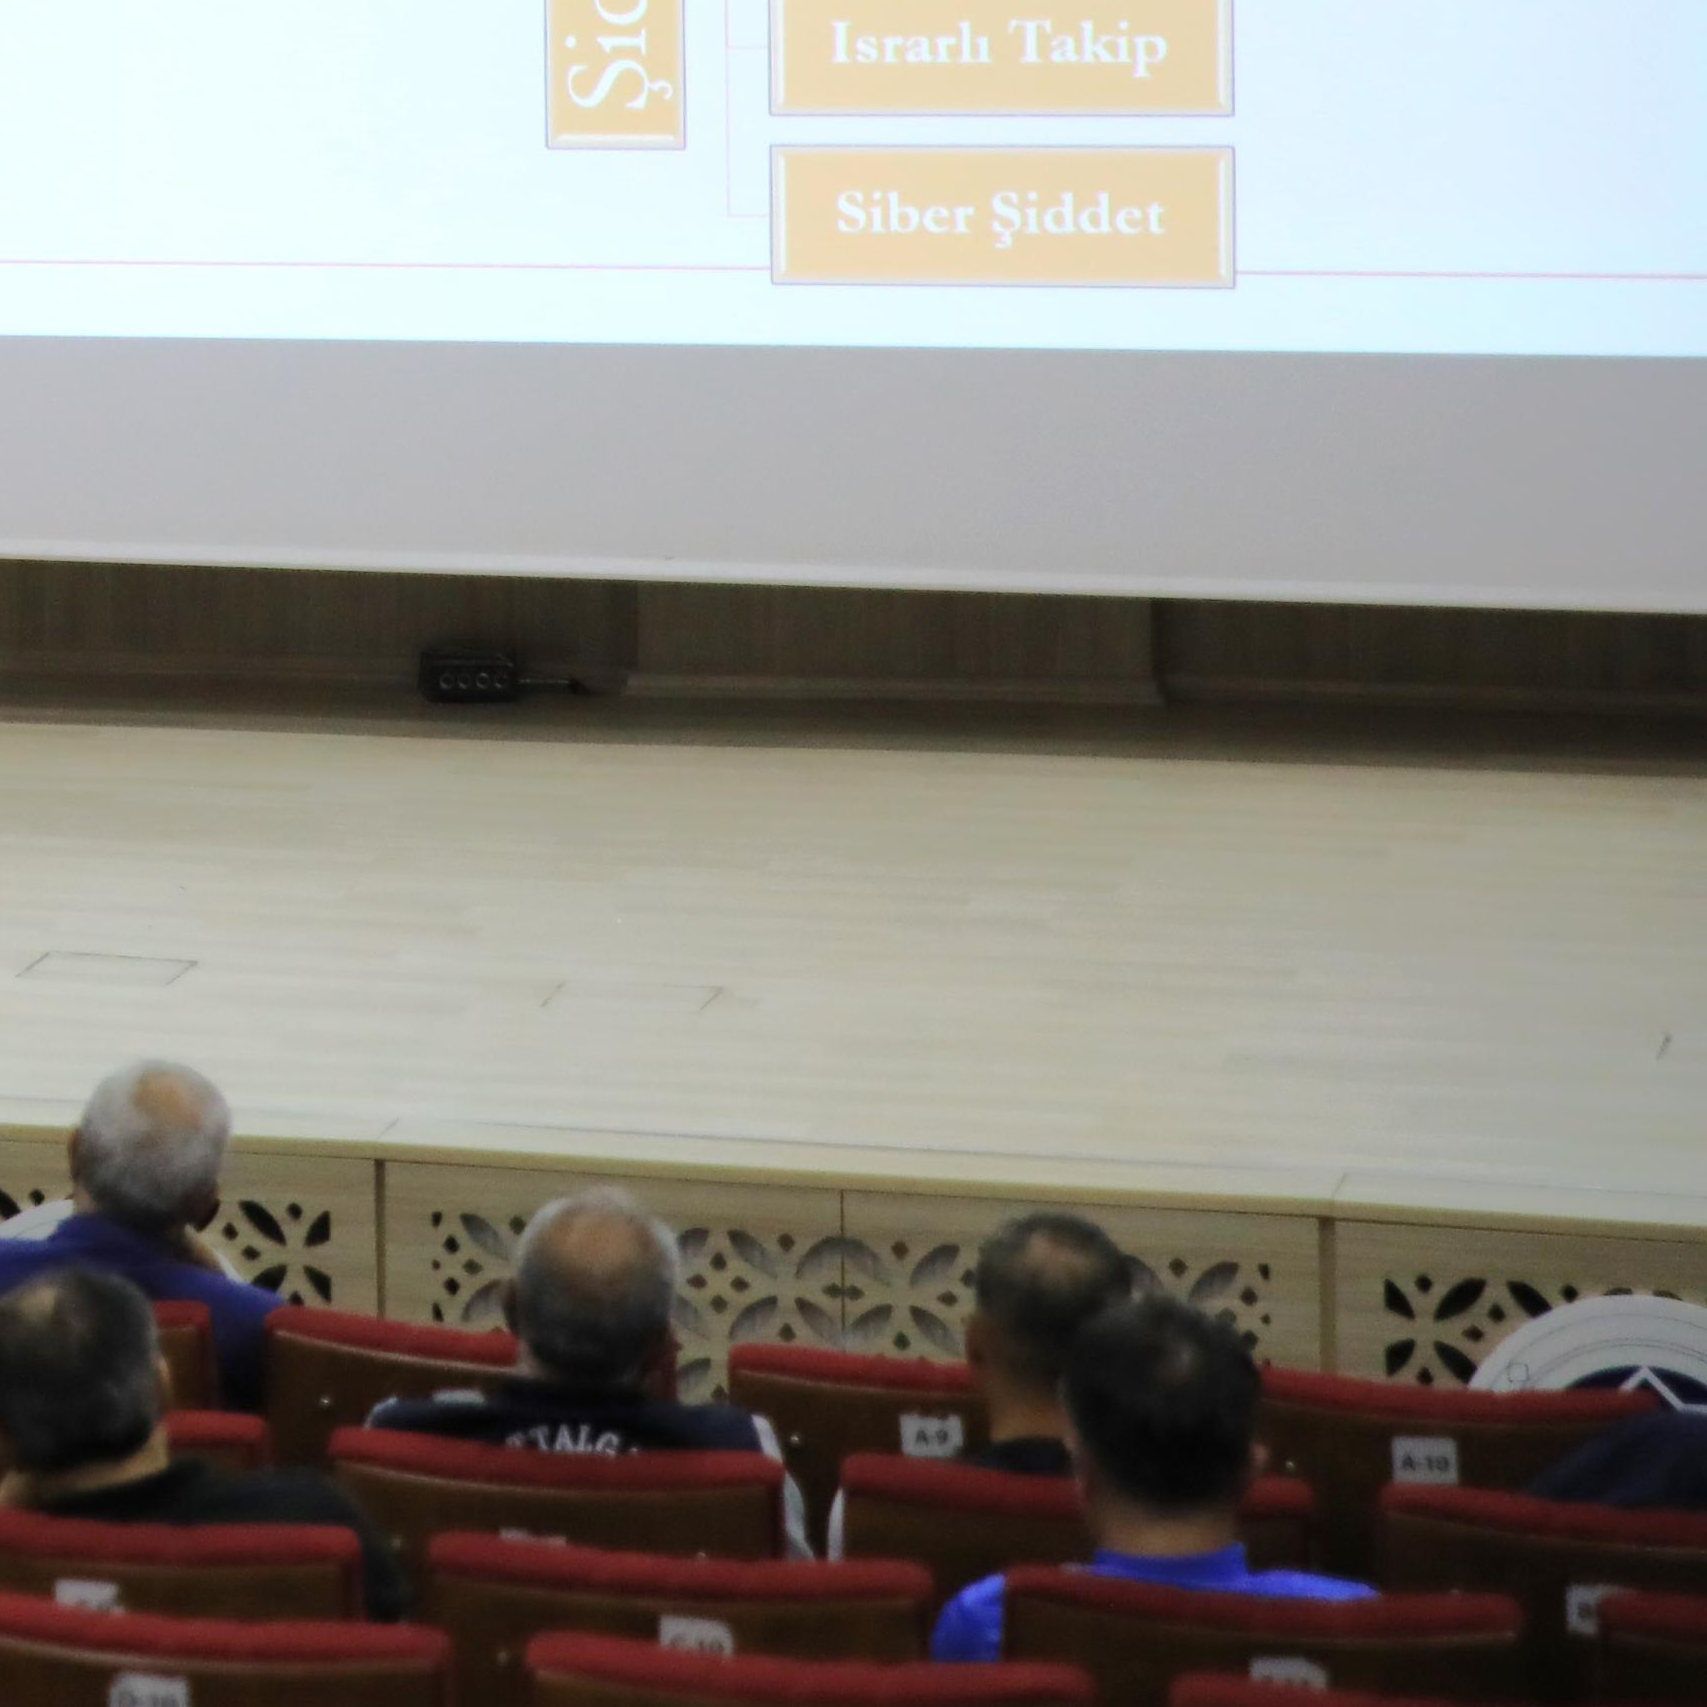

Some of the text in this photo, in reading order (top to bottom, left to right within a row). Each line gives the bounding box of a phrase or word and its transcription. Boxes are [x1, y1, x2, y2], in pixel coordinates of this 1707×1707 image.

[830, 19, 1169, 77] Israrlı Takip
[835, 187, 1166, 248] Siber Şiddet
[915, 1428, 950, 1445] A-9
[1401, 1454, 1450, 1473] A-10
